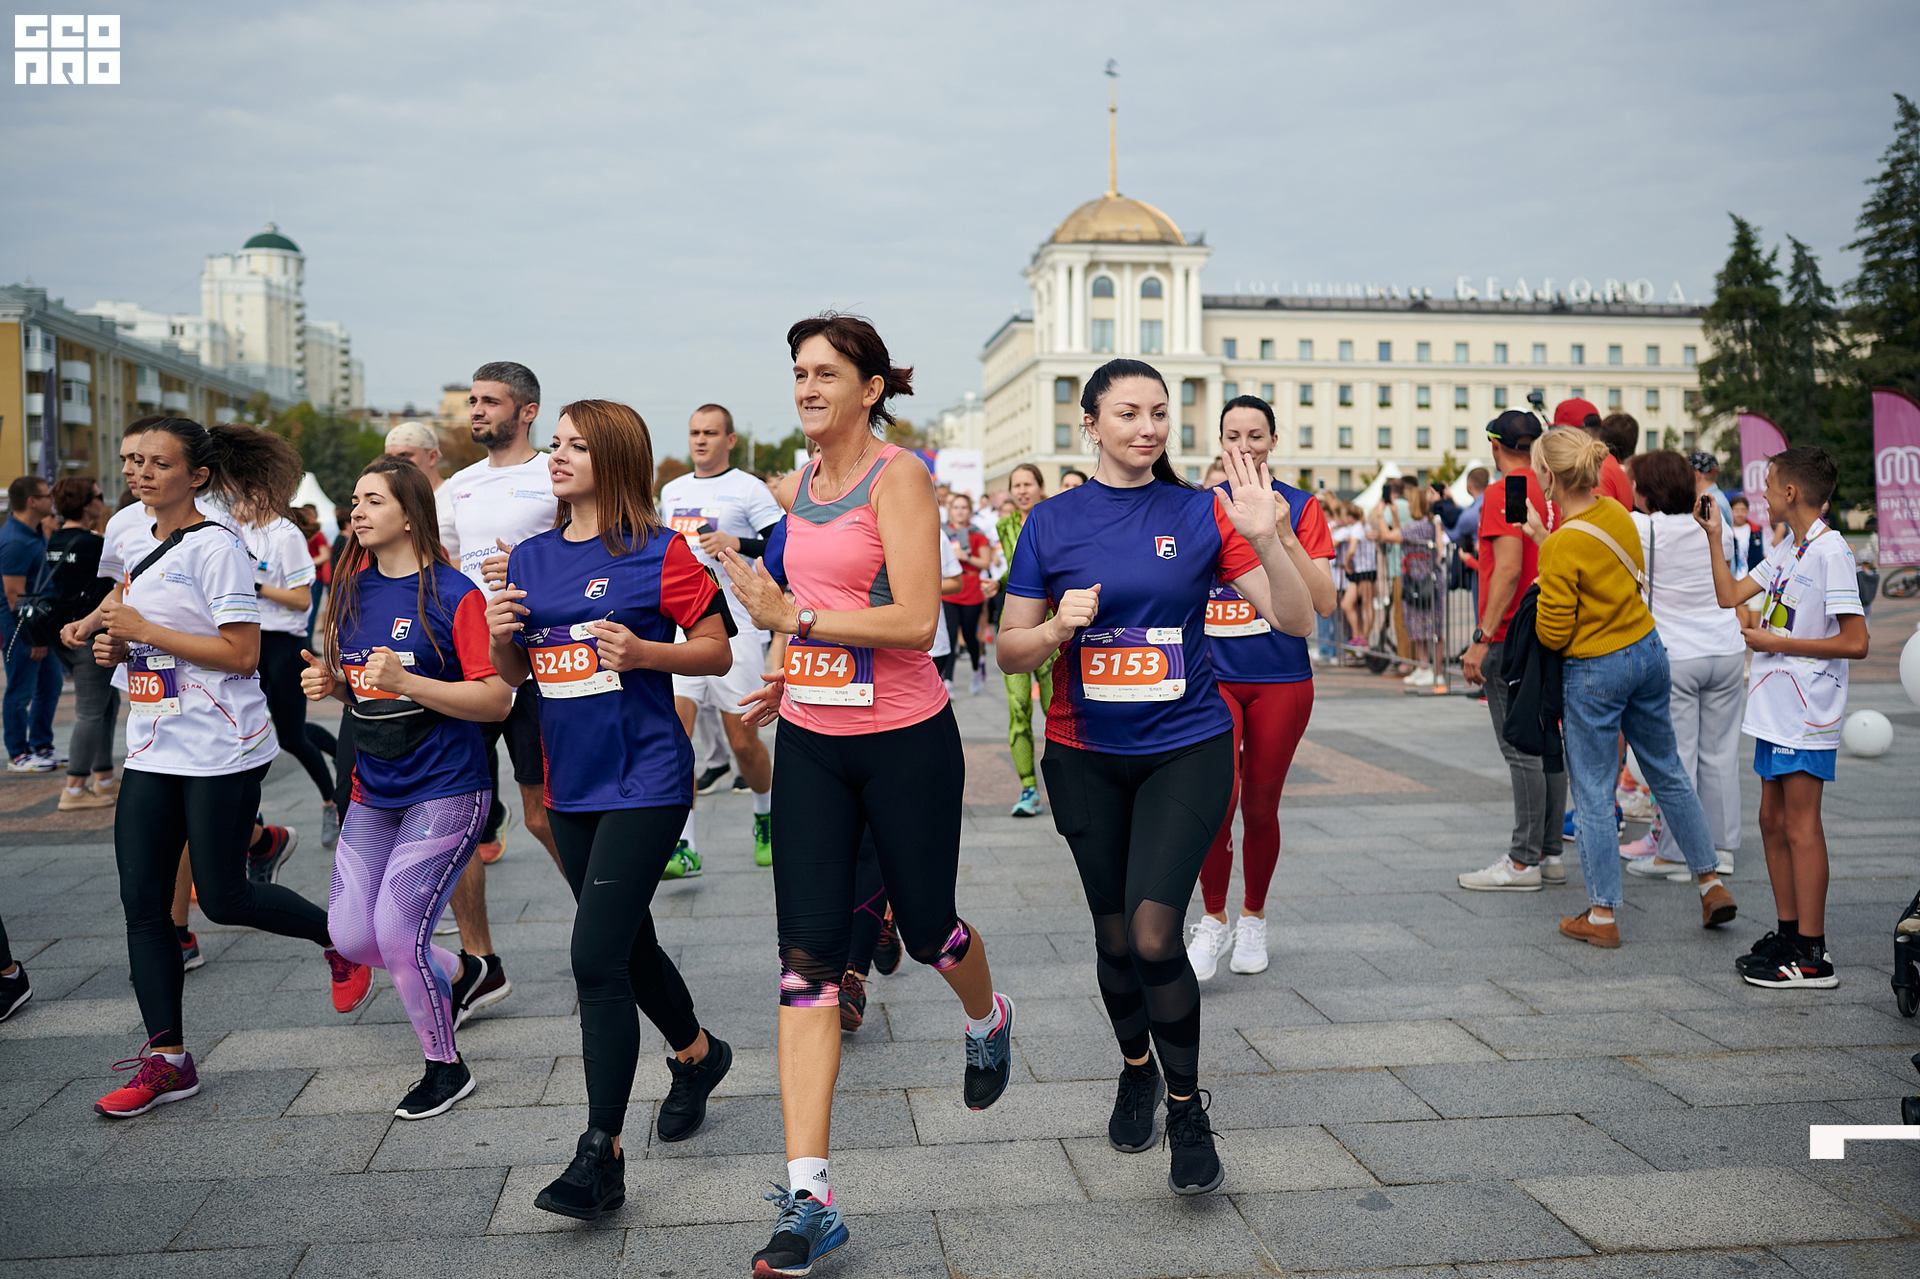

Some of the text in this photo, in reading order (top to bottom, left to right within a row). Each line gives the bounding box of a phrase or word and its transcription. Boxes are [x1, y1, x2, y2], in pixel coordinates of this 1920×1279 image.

[1205, 602, 1250, 620] 5155
[535, 647, 590, 675] 5248
[788, 651, 848, 678] 5154
[1088, 651, 1160, 676] 5153
[129, 675, 159, 696] 5376
